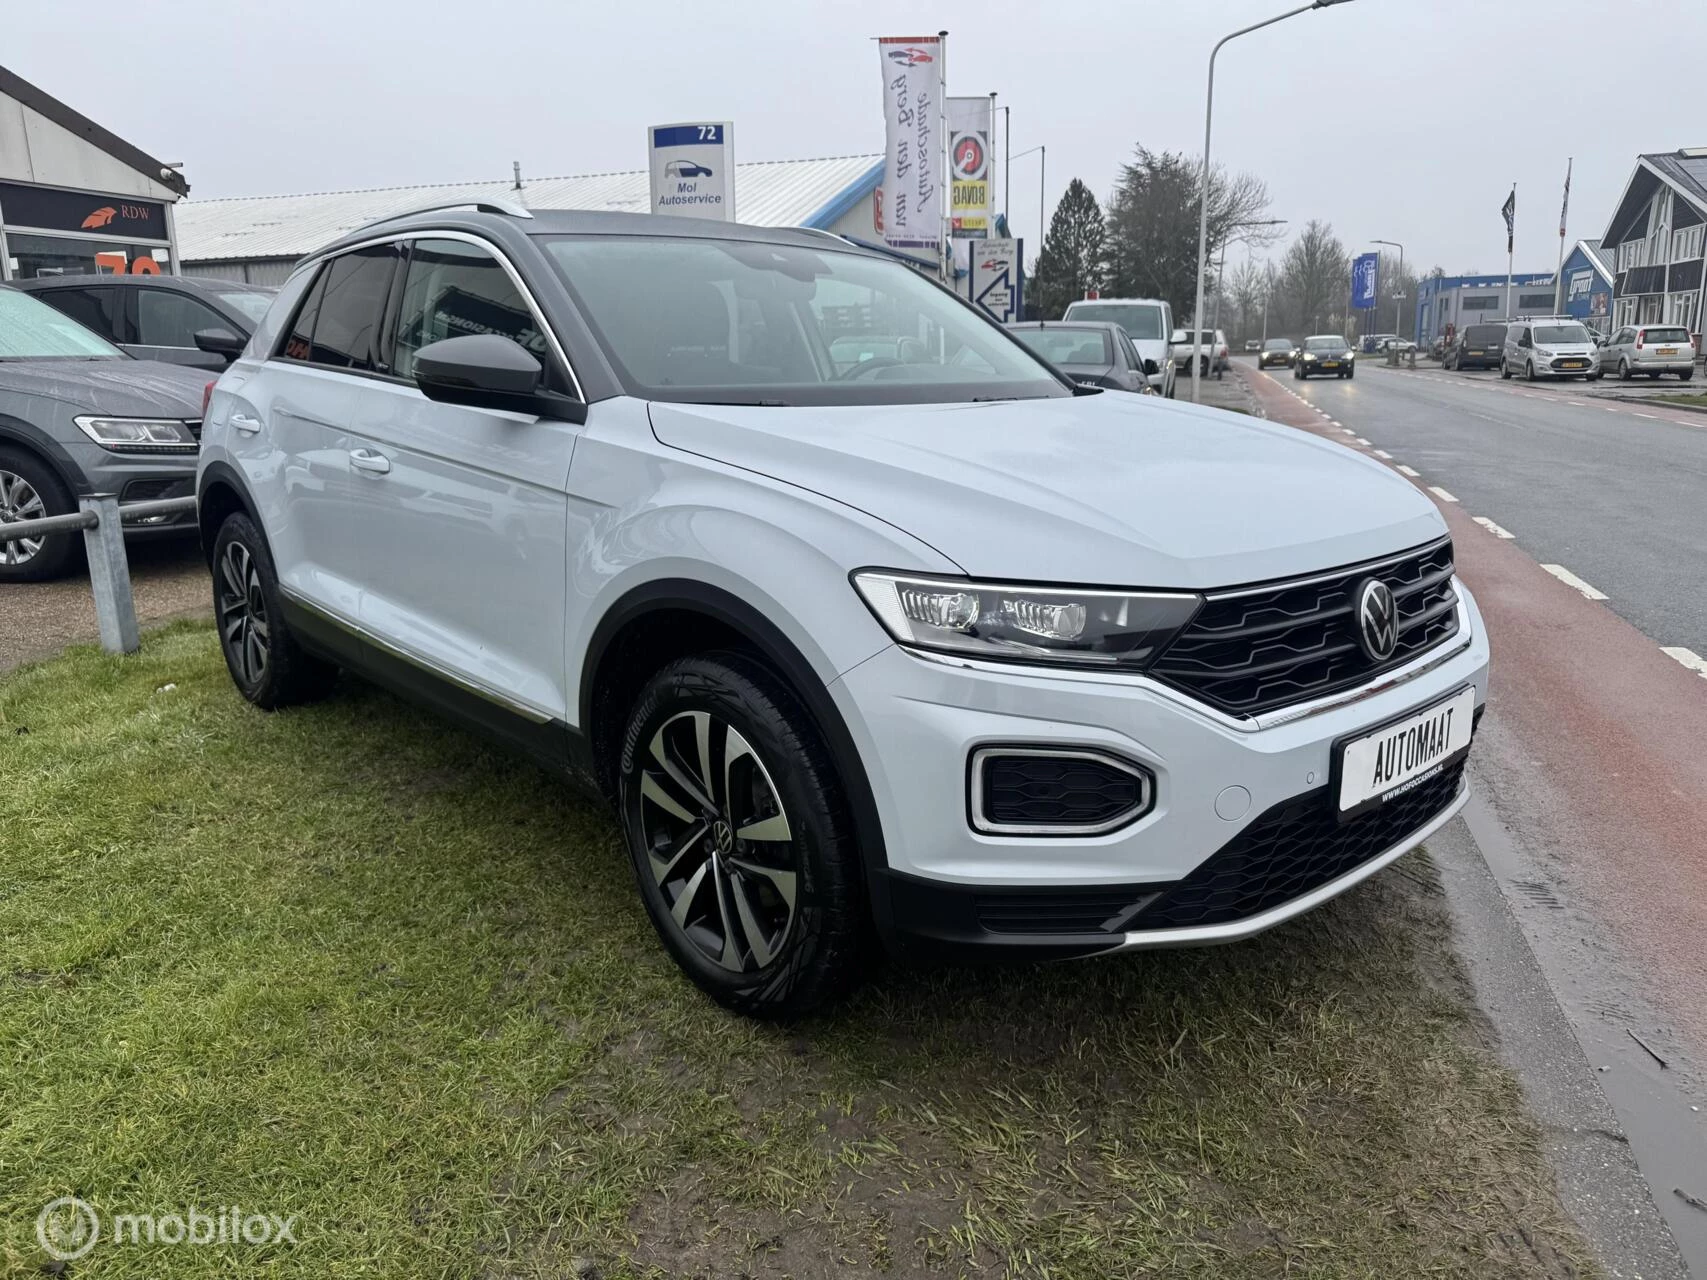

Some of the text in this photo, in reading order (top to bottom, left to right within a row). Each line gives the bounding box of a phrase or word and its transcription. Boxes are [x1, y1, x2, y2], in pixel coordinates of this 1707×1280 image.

[697, 126, 717, 140] 72
[677, 182, 697, 193] Mol
[658, 194, 722, 206] Autoservice
[121, 204, 150, 220] RDW
[1373, 707, 1454, 786] AUTOMAAT
